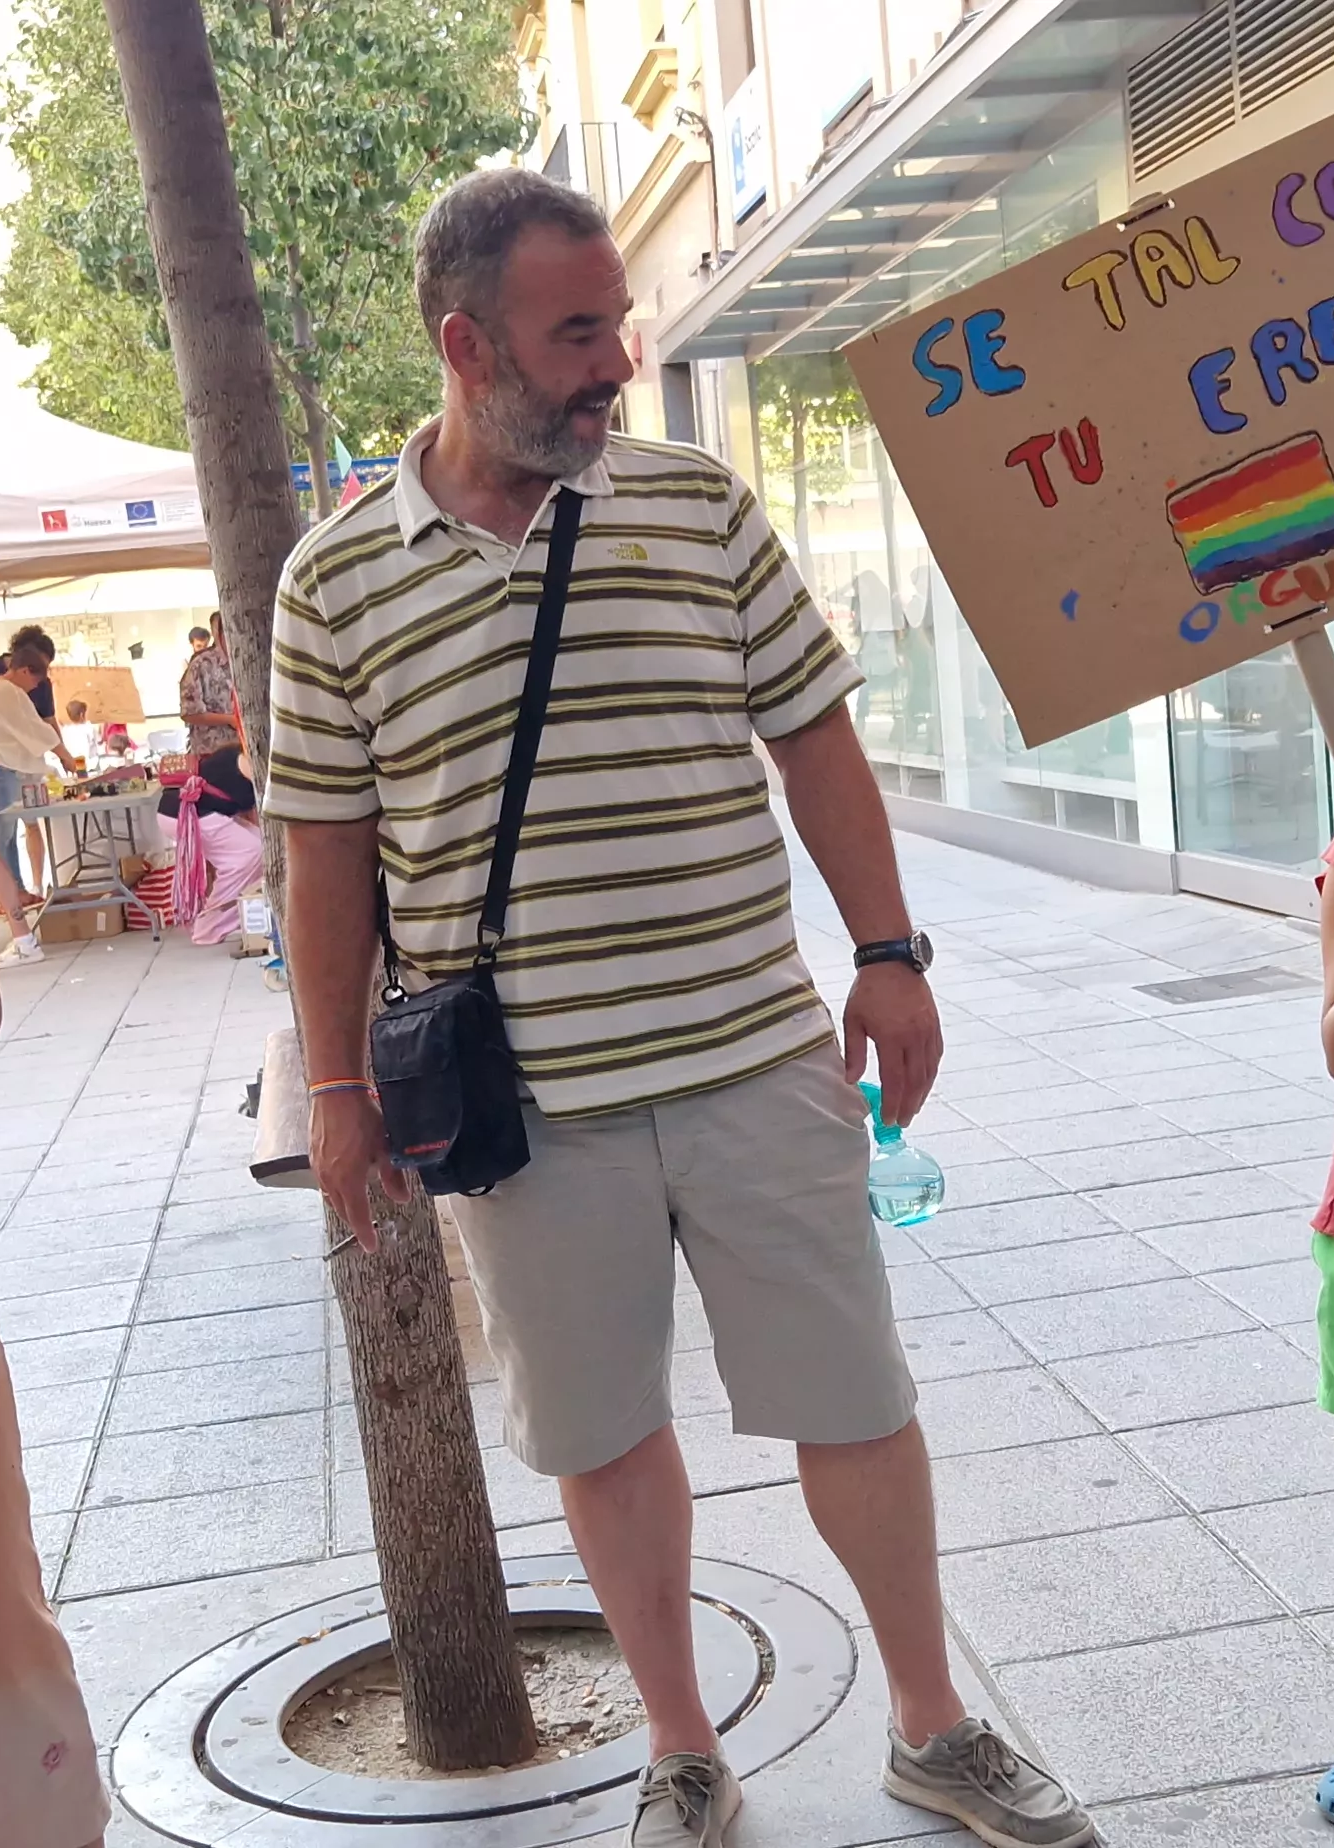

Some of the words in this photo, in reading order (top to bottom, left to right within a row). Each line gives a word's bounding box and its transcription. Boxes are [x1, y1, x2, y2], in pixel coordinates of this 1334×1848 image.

[912, 308, 1026, 417] SE
[1062, 216, 1240, 331] TAL
[1005, 416, 1103, 508] TU
